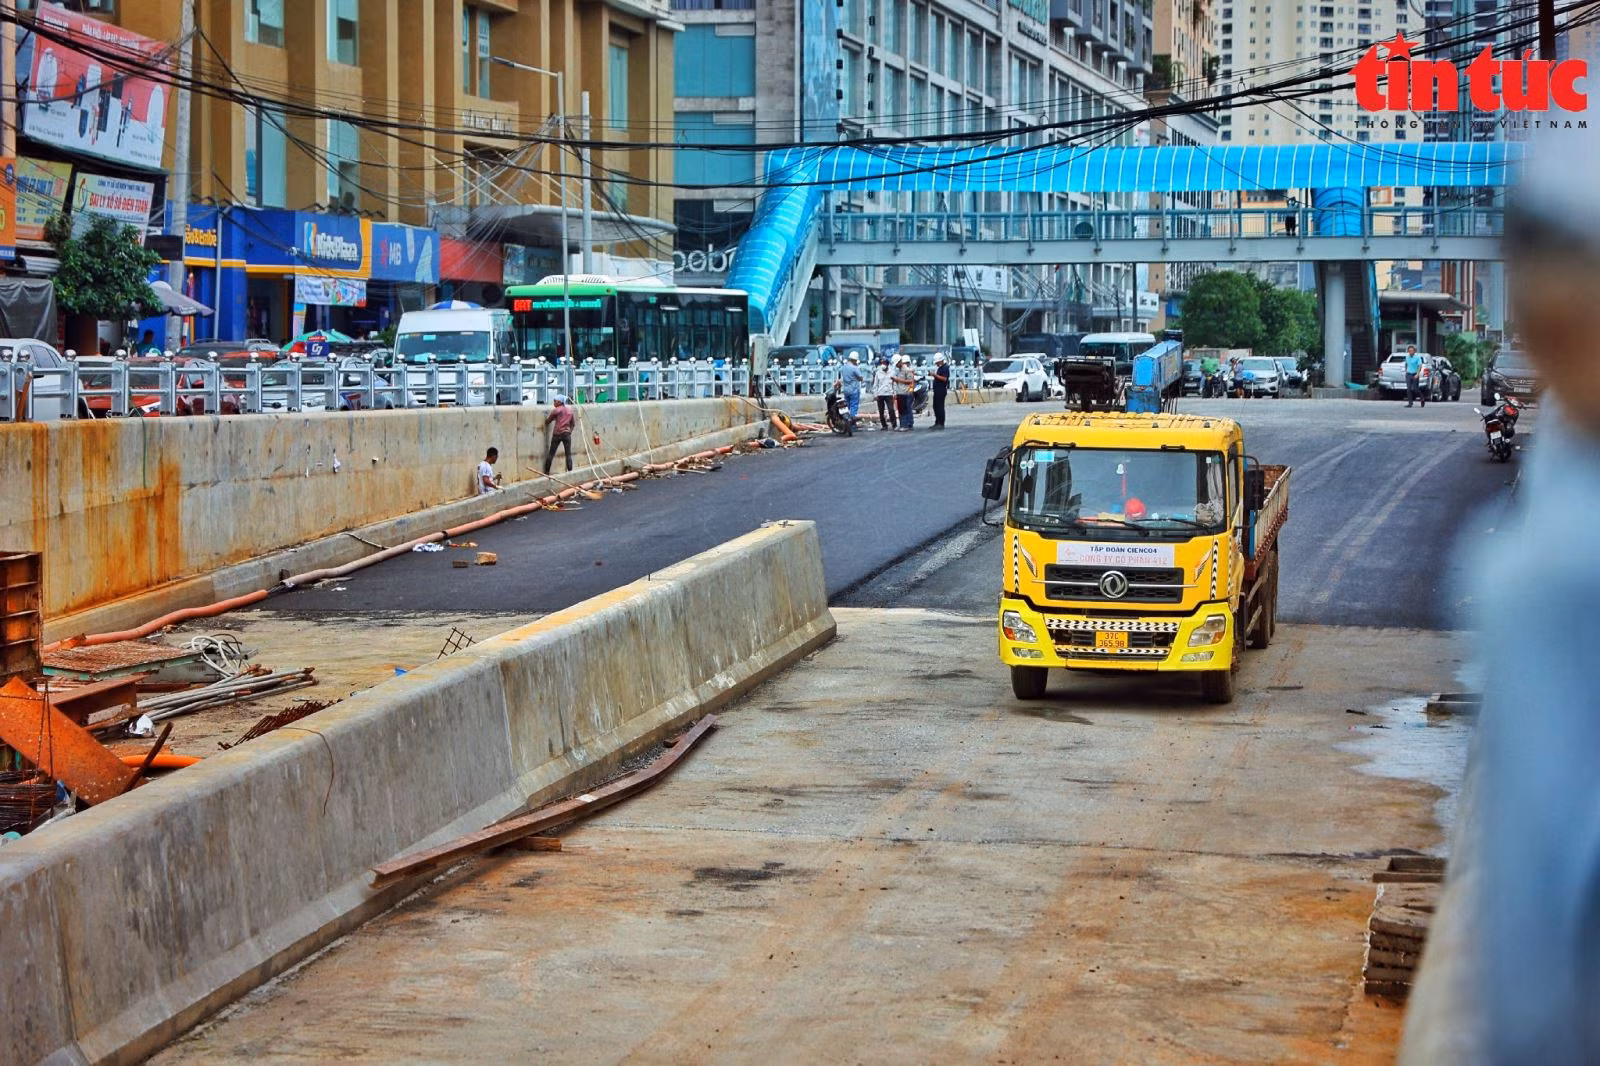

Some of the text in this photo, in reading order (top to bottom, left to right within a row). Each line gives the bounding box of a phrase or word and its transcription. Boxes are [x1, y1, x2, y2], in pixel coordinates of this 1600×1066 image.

[316, 232, 358, 261] KidsPlaza
[388, 241, 402, 266] MB
[1090, 546, 1104, 554] TẬP
[1104, 555, 1113, 564] TY
